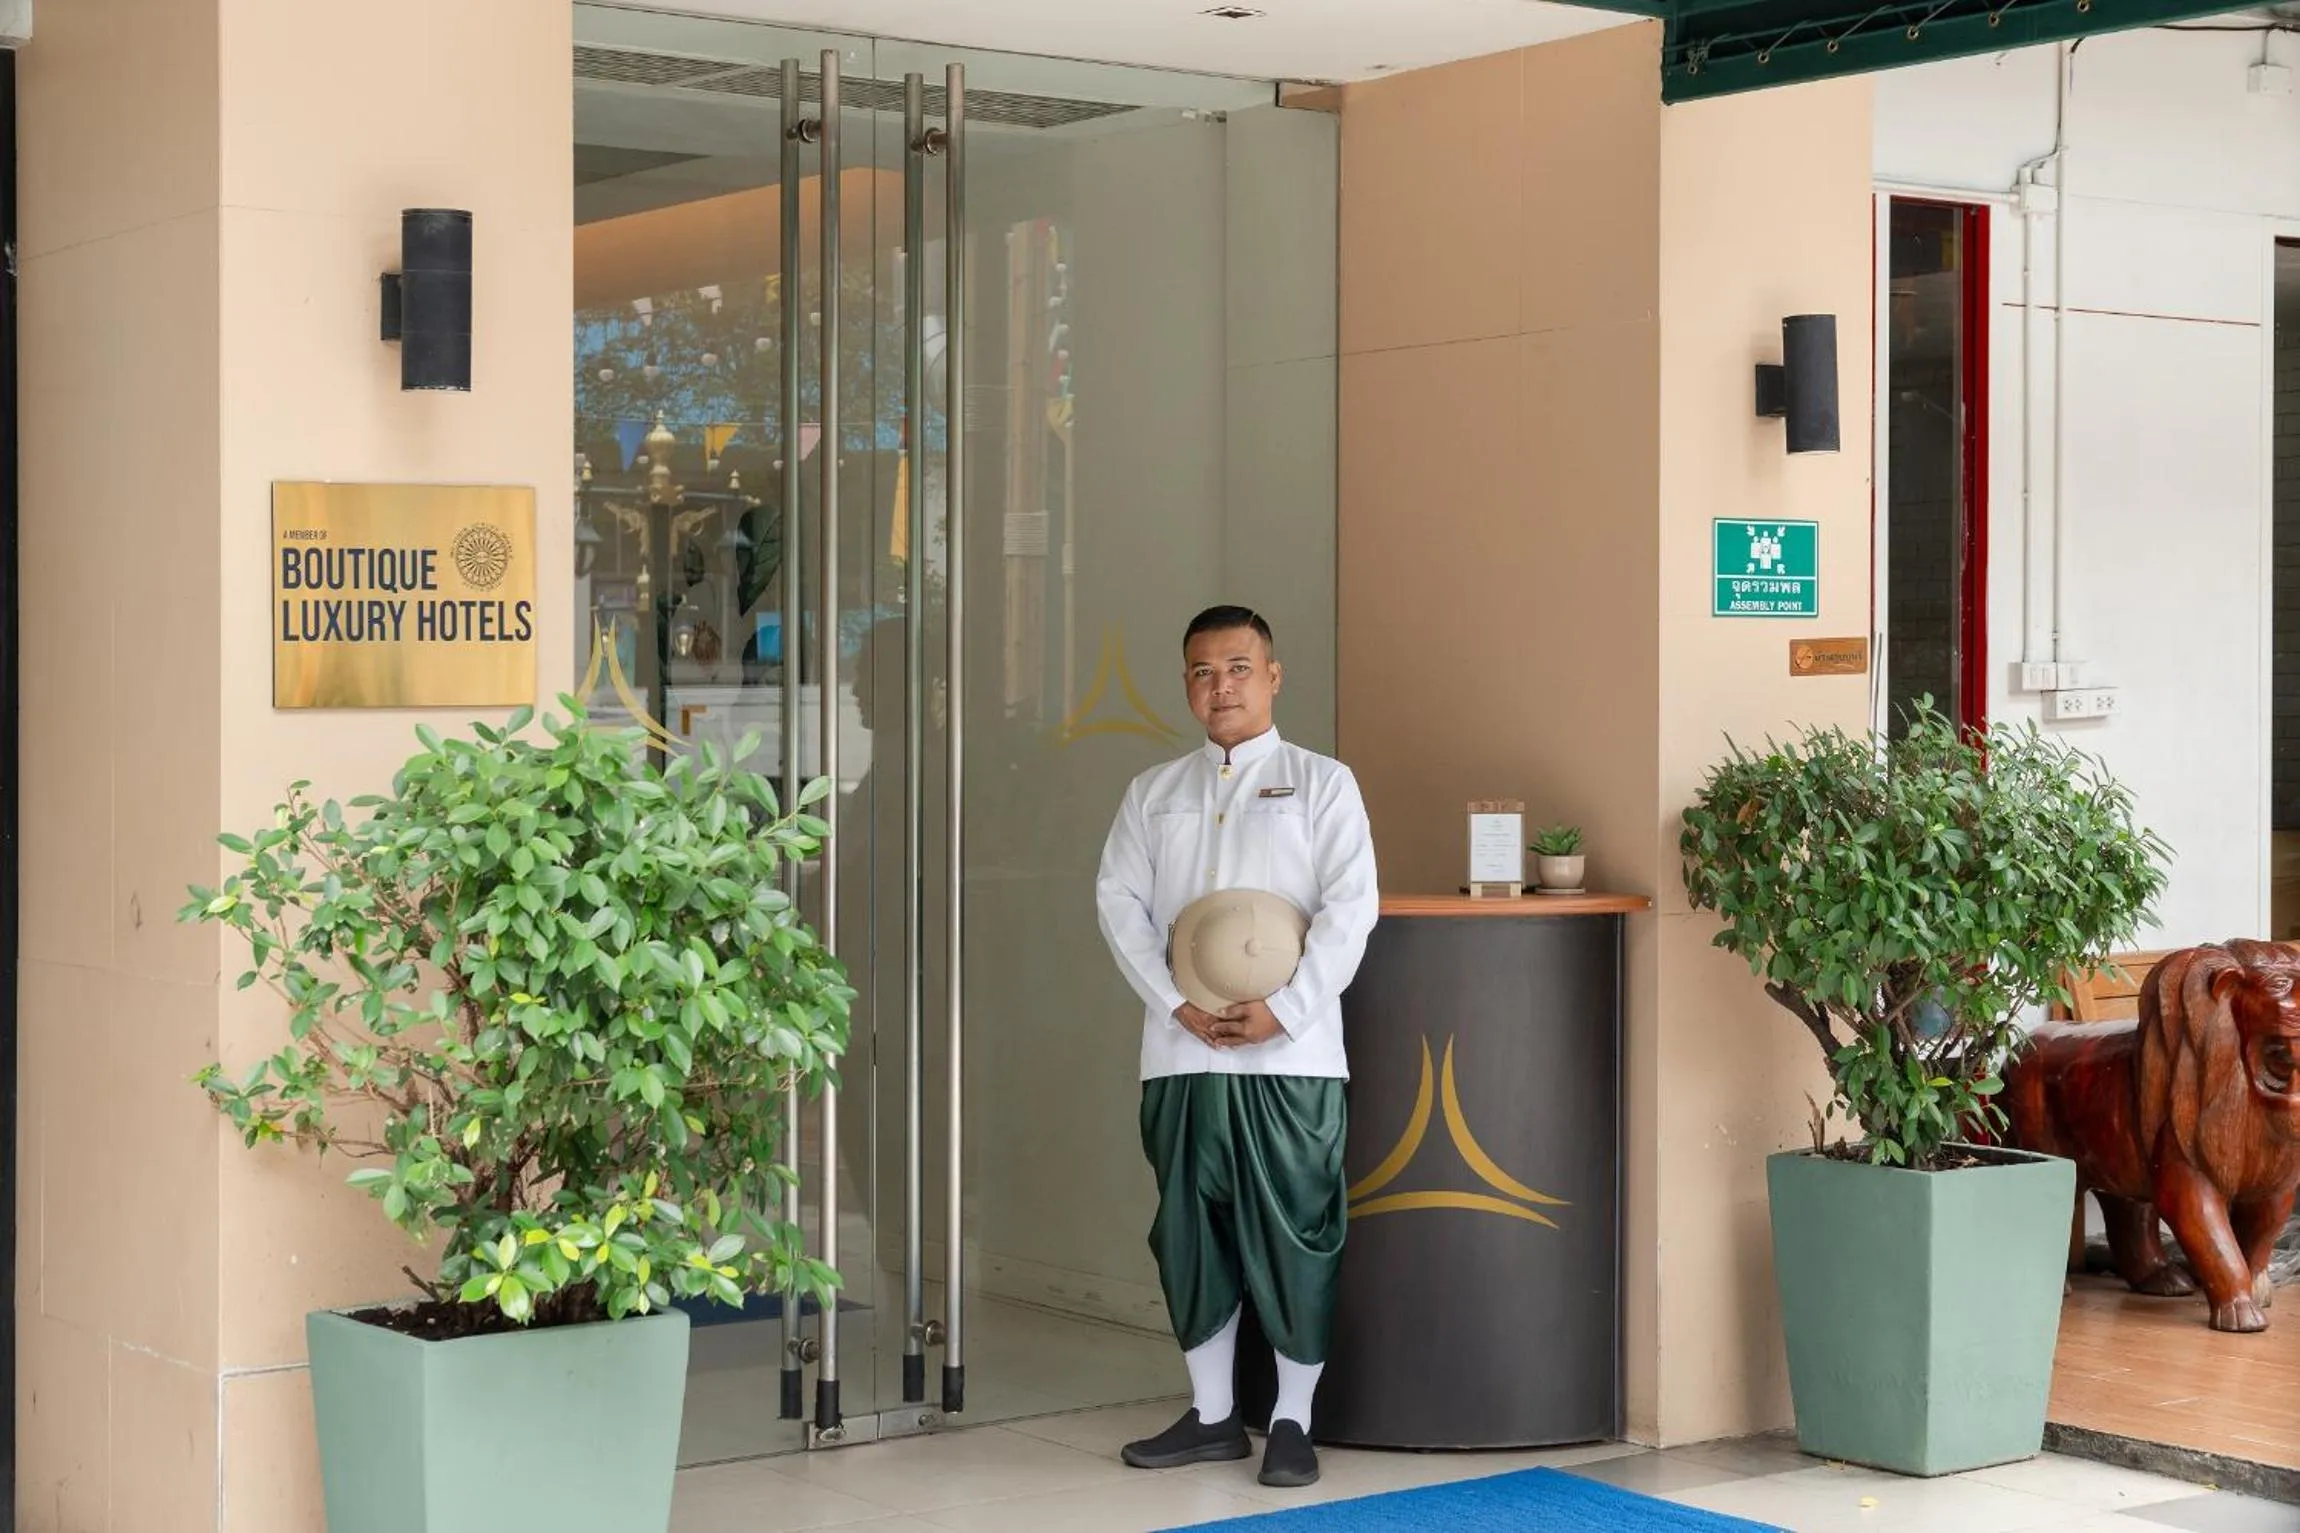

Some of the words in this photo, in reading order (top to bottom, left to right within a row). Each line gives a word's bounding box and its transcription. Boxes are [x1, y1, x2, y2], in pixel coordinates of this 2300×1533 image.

[283, 530, 288, 540] A
[289, 530, 318, 540] MEMBER
[319, 530, 328, 540] OF
[282, 547, 438, 593] BOUTIQUE
[1732, 580, 1801, 599] จุดรวมพล
[1729, 600, 1775, 611] ASSEMBLY
[1777, 601, 1802, 611] POINT
[282, 600, 406, 641] LUXURY
[418, 600, 532, 641] HOTELS
